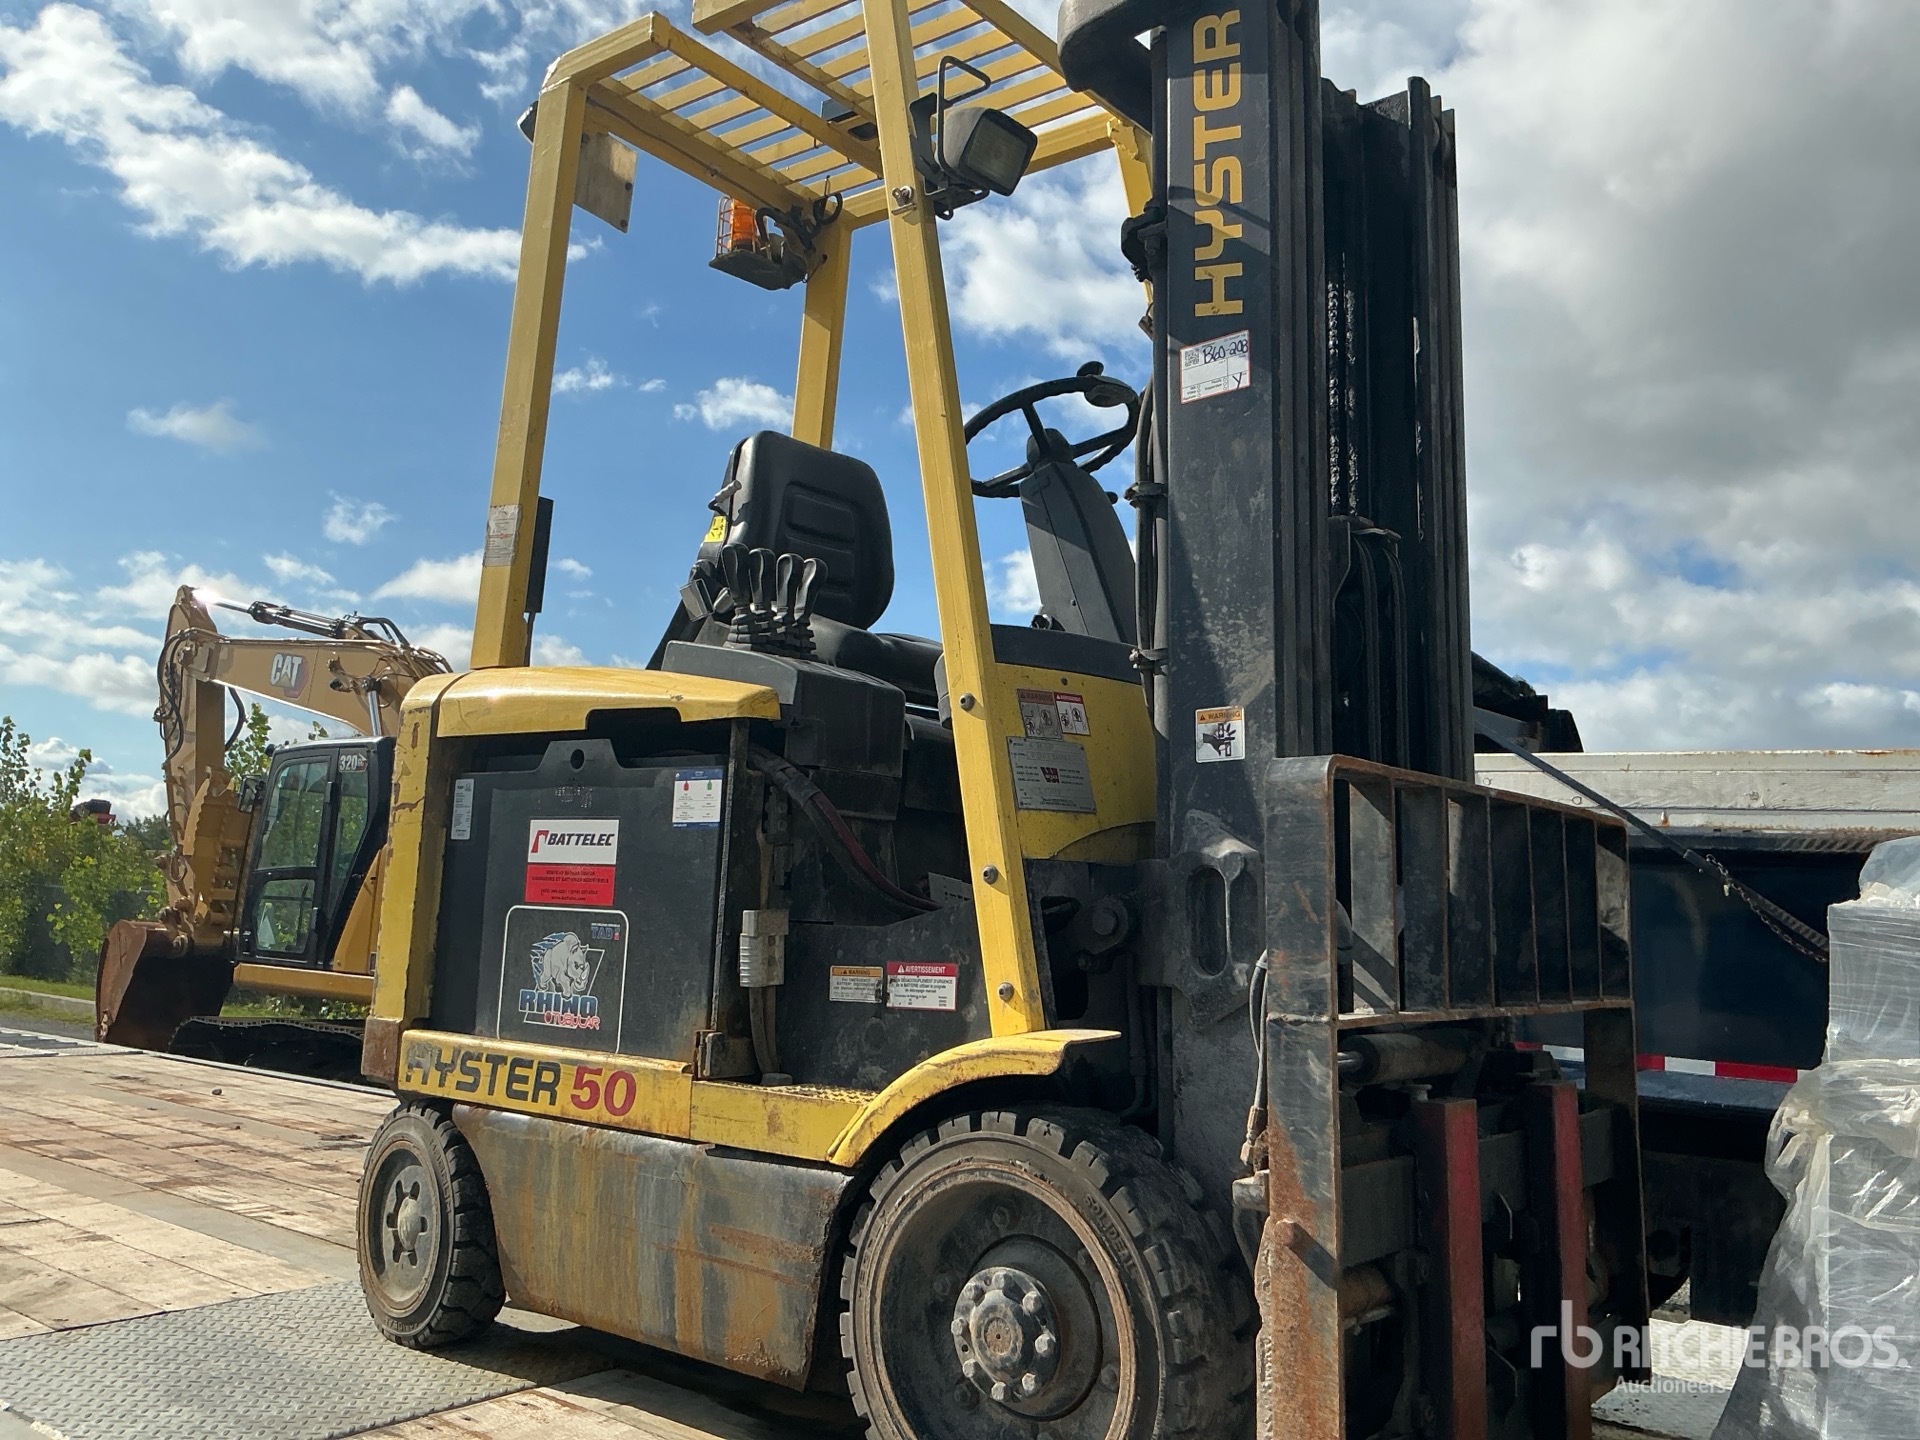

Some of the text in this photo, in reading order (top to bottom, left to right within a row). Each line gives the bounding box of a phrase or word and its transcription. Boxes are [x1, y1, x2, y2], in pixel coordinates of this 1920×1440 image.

[1192, 9, 1243, 317] HYSTER
[270, 653, 303, 688] CAT
[1207, 710, 1241, 720] WARNG
[340, 754, 357, 771] 320
[547, 832, 615, 847] BATTELEC
[590, 926, 614, 940] TAB
[905, 965, 946, 974] AVERTISSEMENT
[518, 988, 598, 1018] RHINO
[405, 1041, 637, 1117] HYSTER 50
